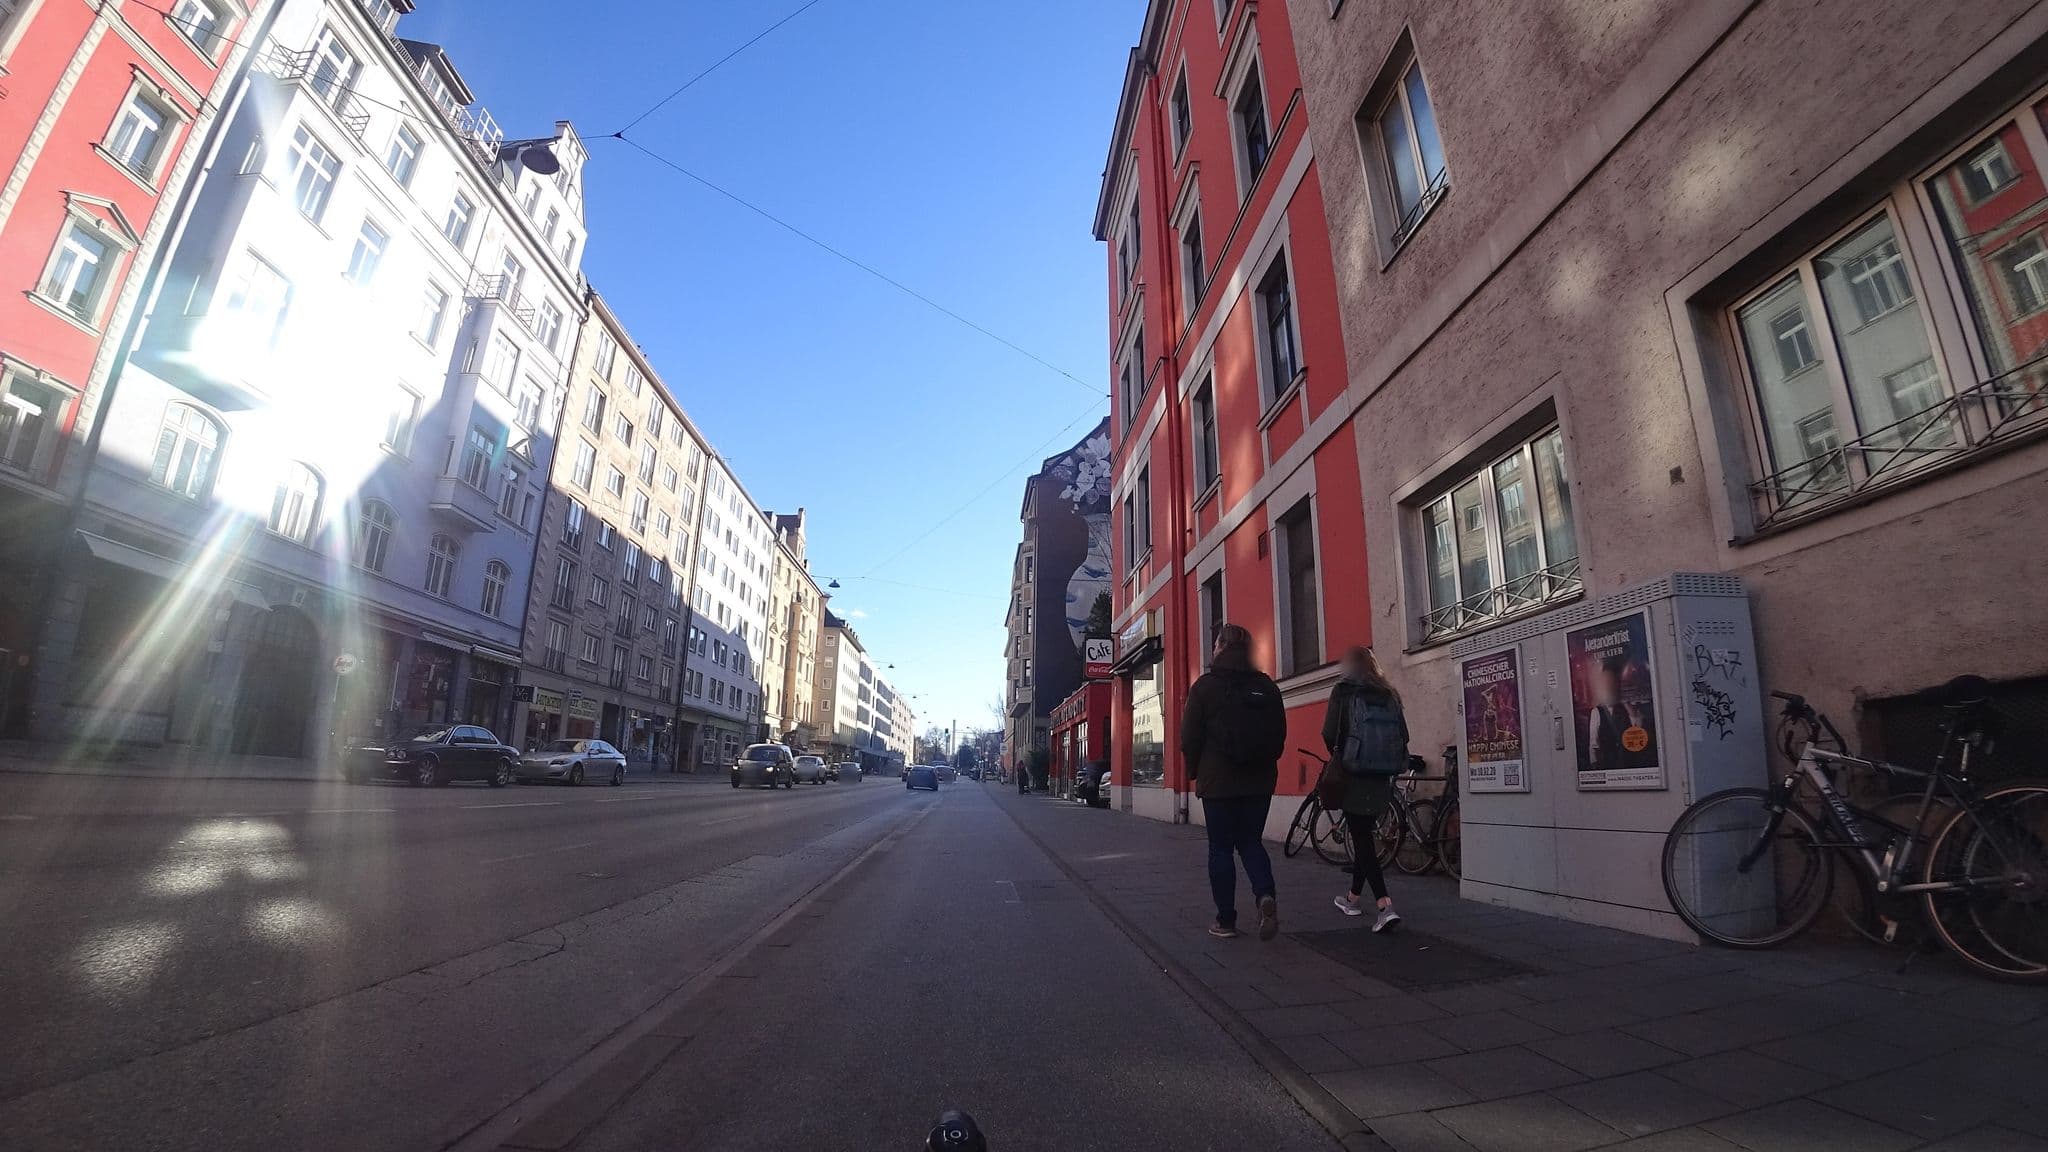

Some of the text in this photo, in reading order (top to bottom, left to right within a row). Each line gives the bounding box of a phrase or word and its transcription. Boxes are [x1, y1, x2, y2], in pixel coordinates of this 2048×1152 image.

[1468, 661, 1509, 678] CHINESISCHER
[1464, 670, 1515, 687] NATIONALCIRCUS
[1490, 740, 1519, 750] CHINESE
